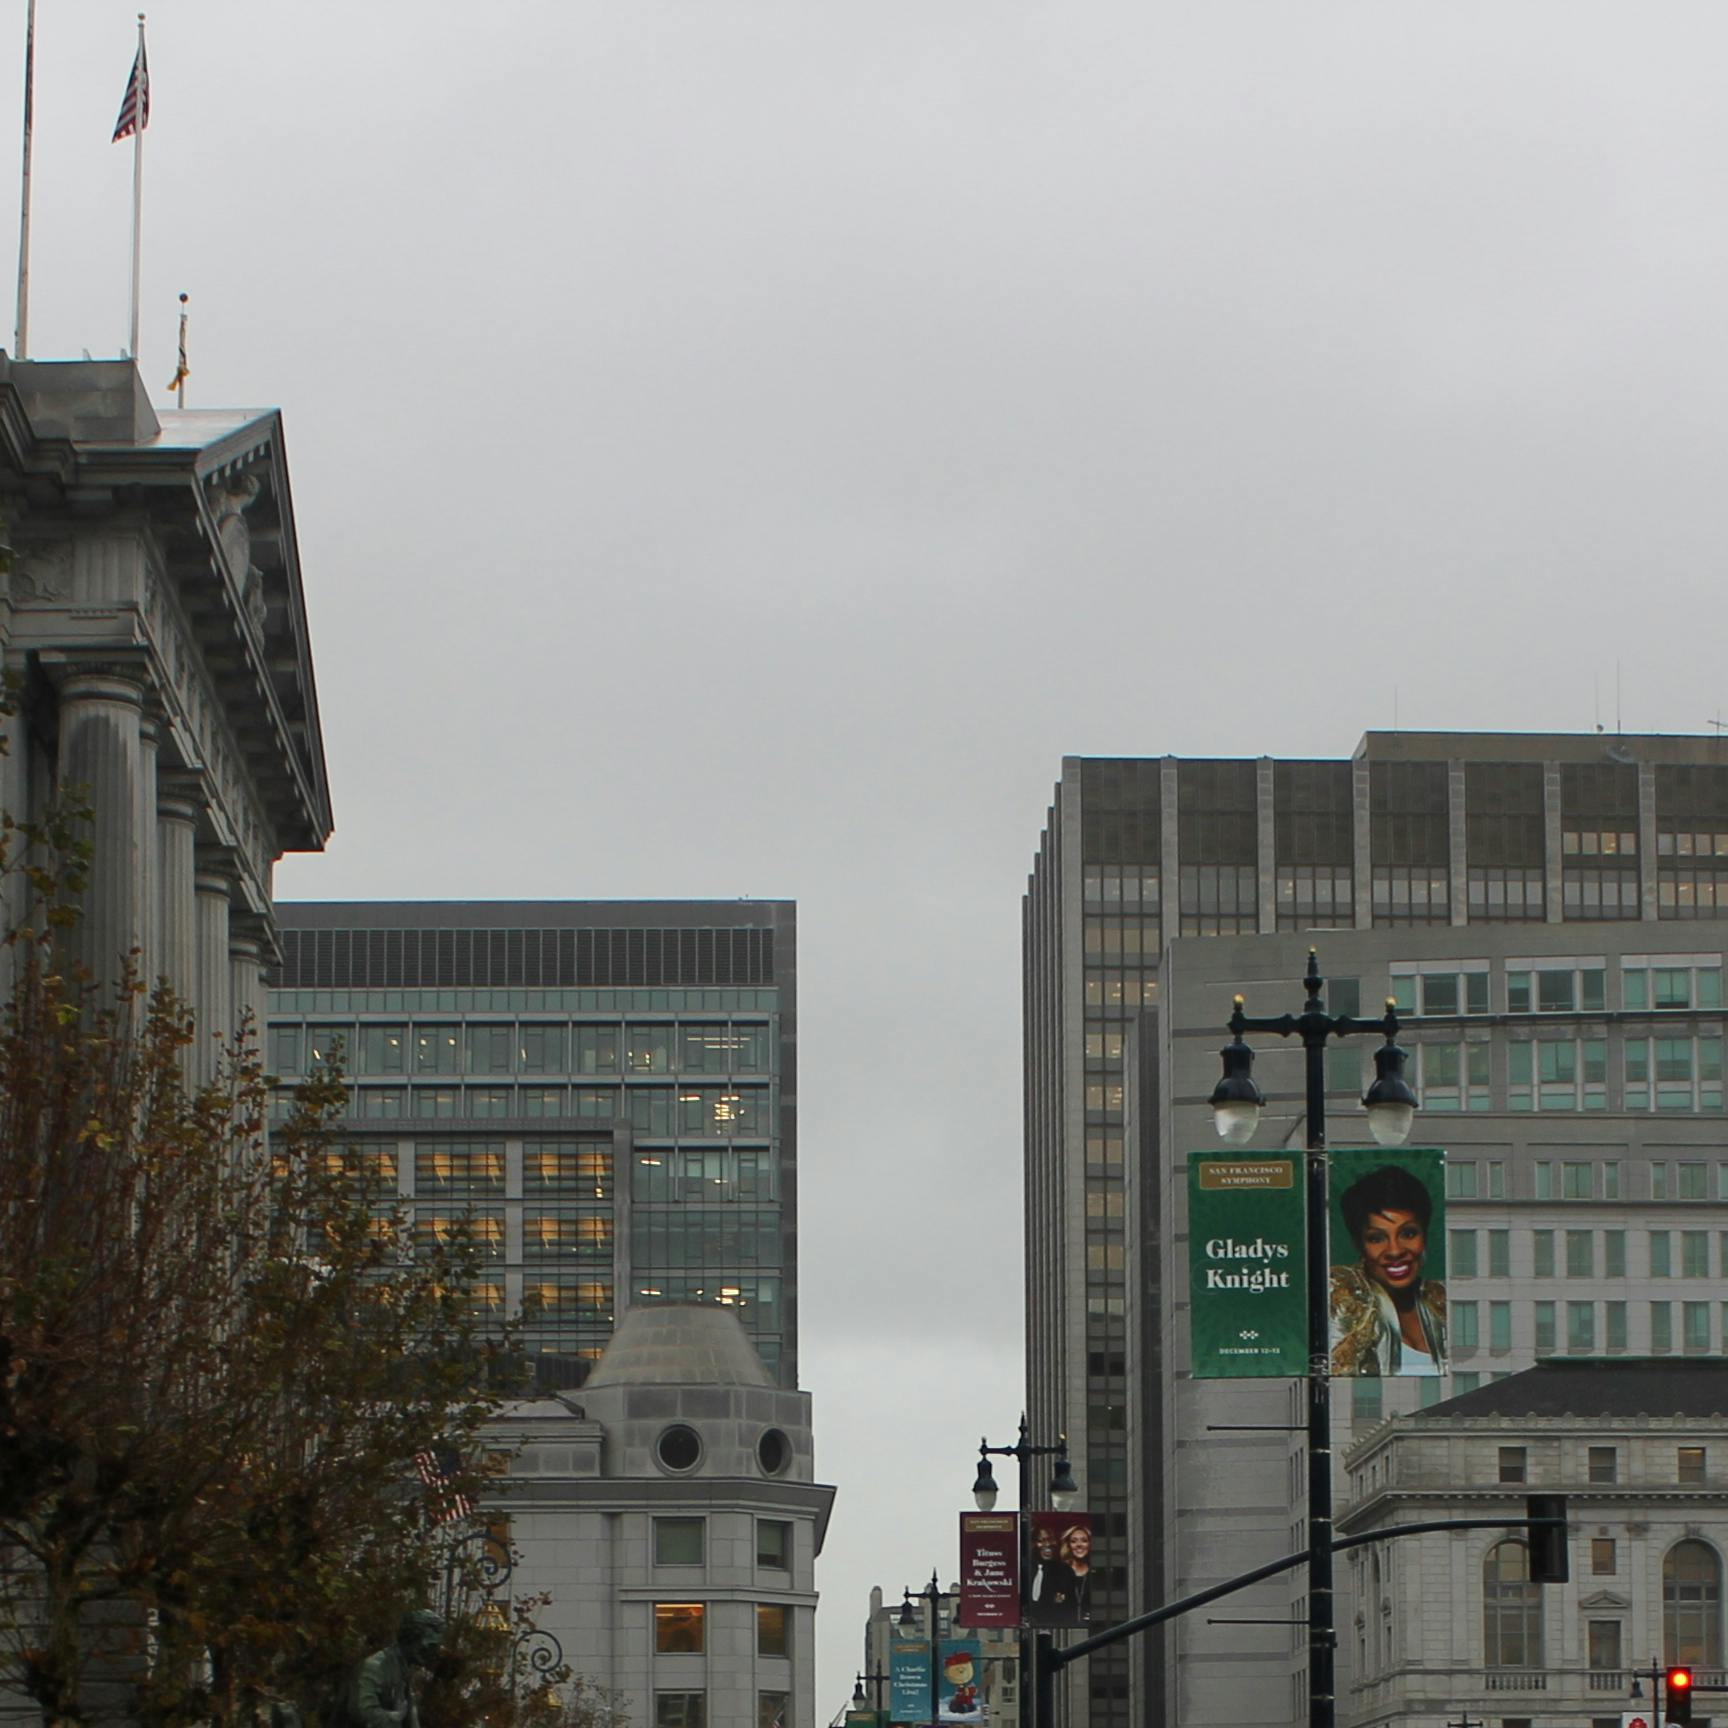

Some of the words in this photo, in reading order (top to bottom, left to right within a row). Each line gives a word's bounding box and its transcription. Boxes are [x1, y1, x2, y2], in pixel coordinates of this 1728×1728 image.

[1209, 1167, 1227, 1175] SAN
[1230, 1167, 1283, 1175] FRANCISCO
[1205, 1238, 1289, 1263] Gladys
[1206, 1267, 1290, 1293] Knight
